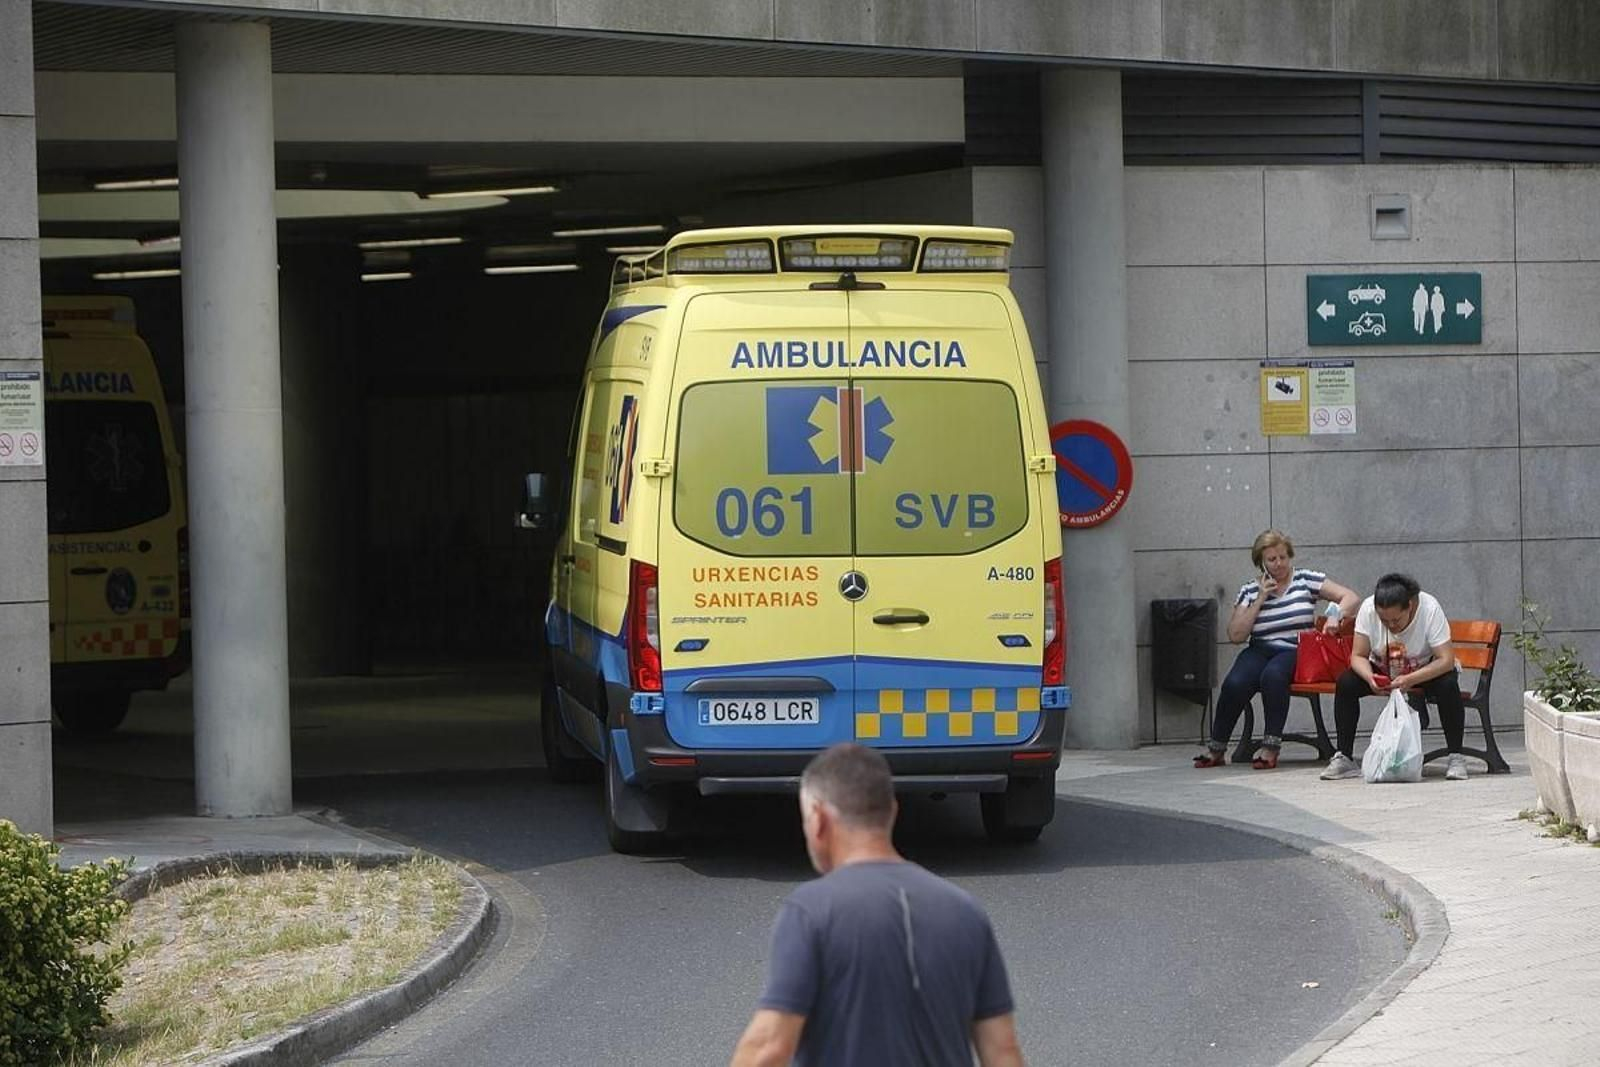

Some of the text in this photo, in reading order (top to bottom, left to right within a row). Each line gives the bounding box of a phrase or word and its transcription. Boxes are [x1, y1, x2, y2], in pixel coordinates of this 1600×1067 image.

[731, 341, 966, 369] AMBULANCIA
[716, 486, 813, 537] 061
[895, 493, 996, 529] SVB
[1070, 489, 1125, 524] AMBULANCIAS
[693, 566, 819, 582] URXENCIAS
[987, 567, 1034, 581] A-480
[694, 592, 818, 608] SANITARIAS
[672, 616, 747, 624] SPRINTER
[713, 702, 766, 721] 0648
[774, 702, 813, 720] LCR
